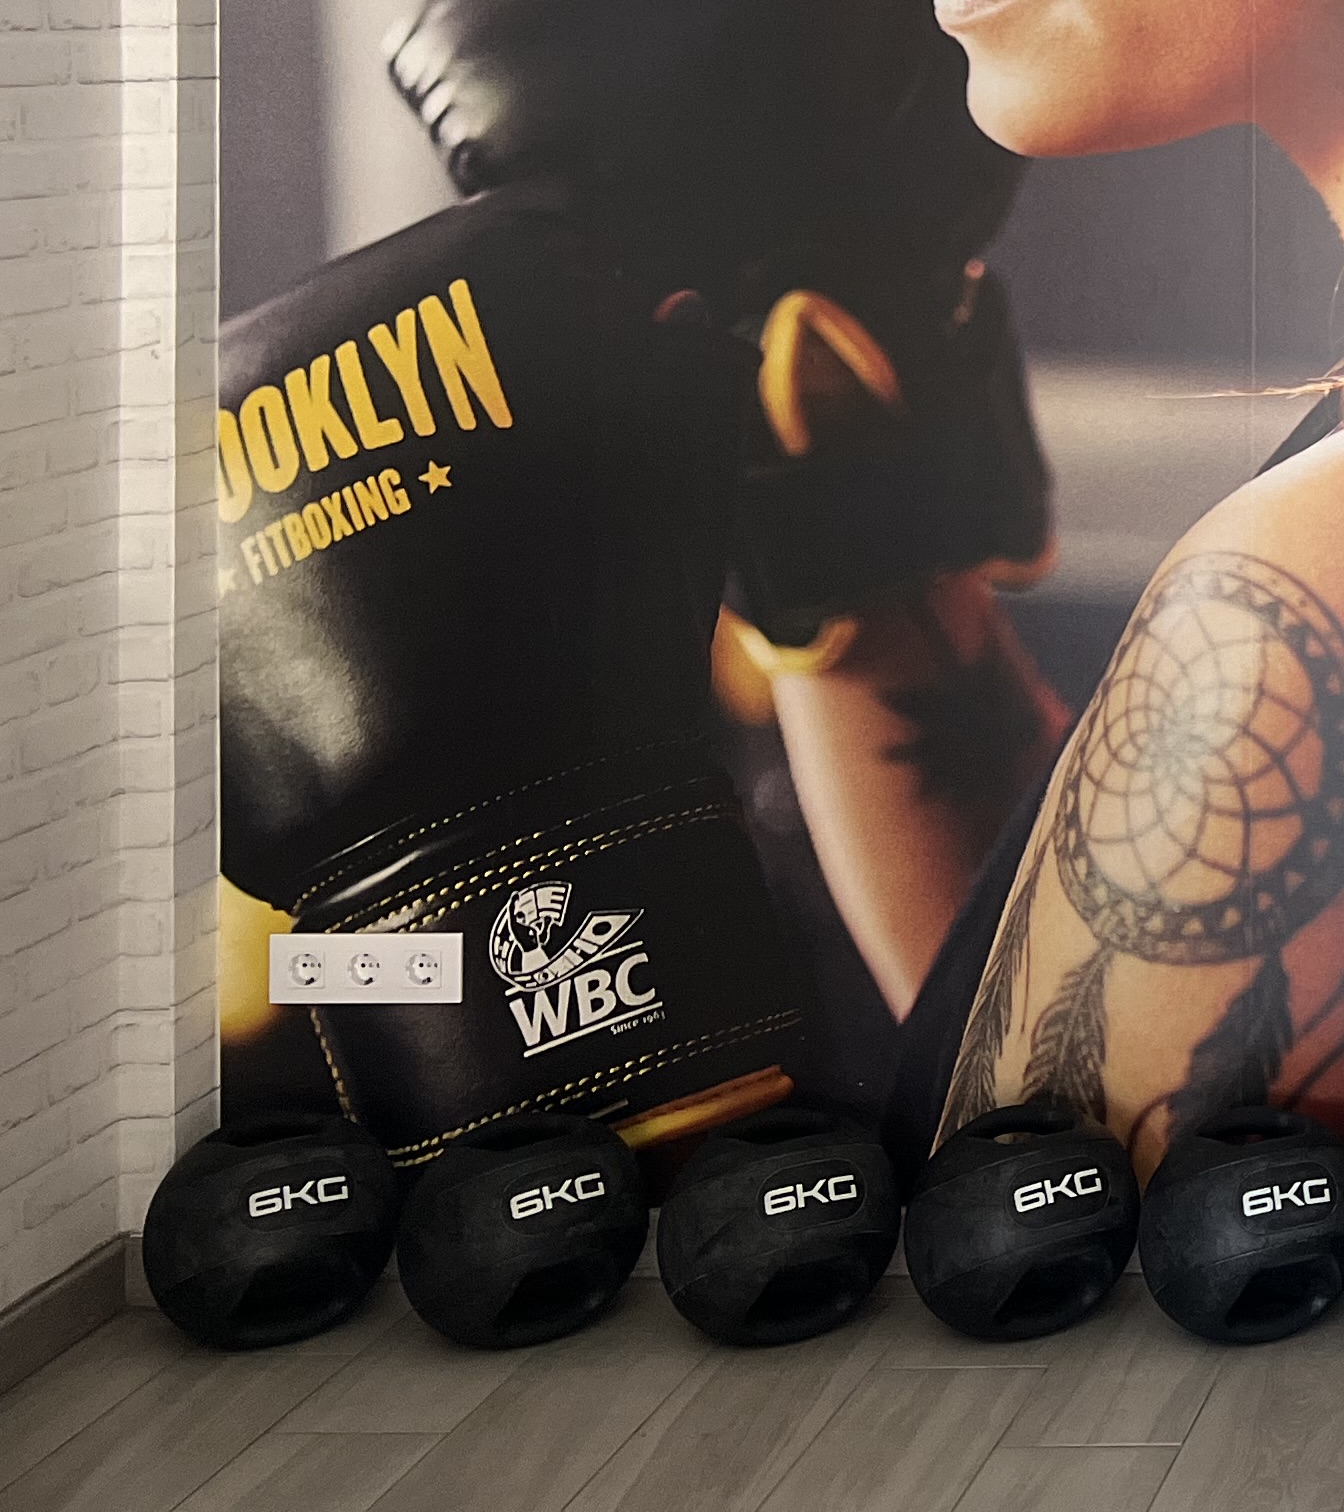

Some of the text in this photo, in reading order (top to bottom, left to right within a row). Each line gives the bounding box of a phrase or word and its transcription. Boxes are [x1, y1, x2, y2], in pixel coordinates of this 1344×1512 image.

[240, 468, 411, 585] FITBOXING
[508, 952, 656, 1047] WBC
[248, 1175, 349, 1217] 6KG
[510, 1172, 605, 1219] 6KG
[764, 1174, 857, 1216] 6KG
[1013, 1168, 1102, 1213] 6KG
[1242, 1178, 1331, 1217] 6KG
